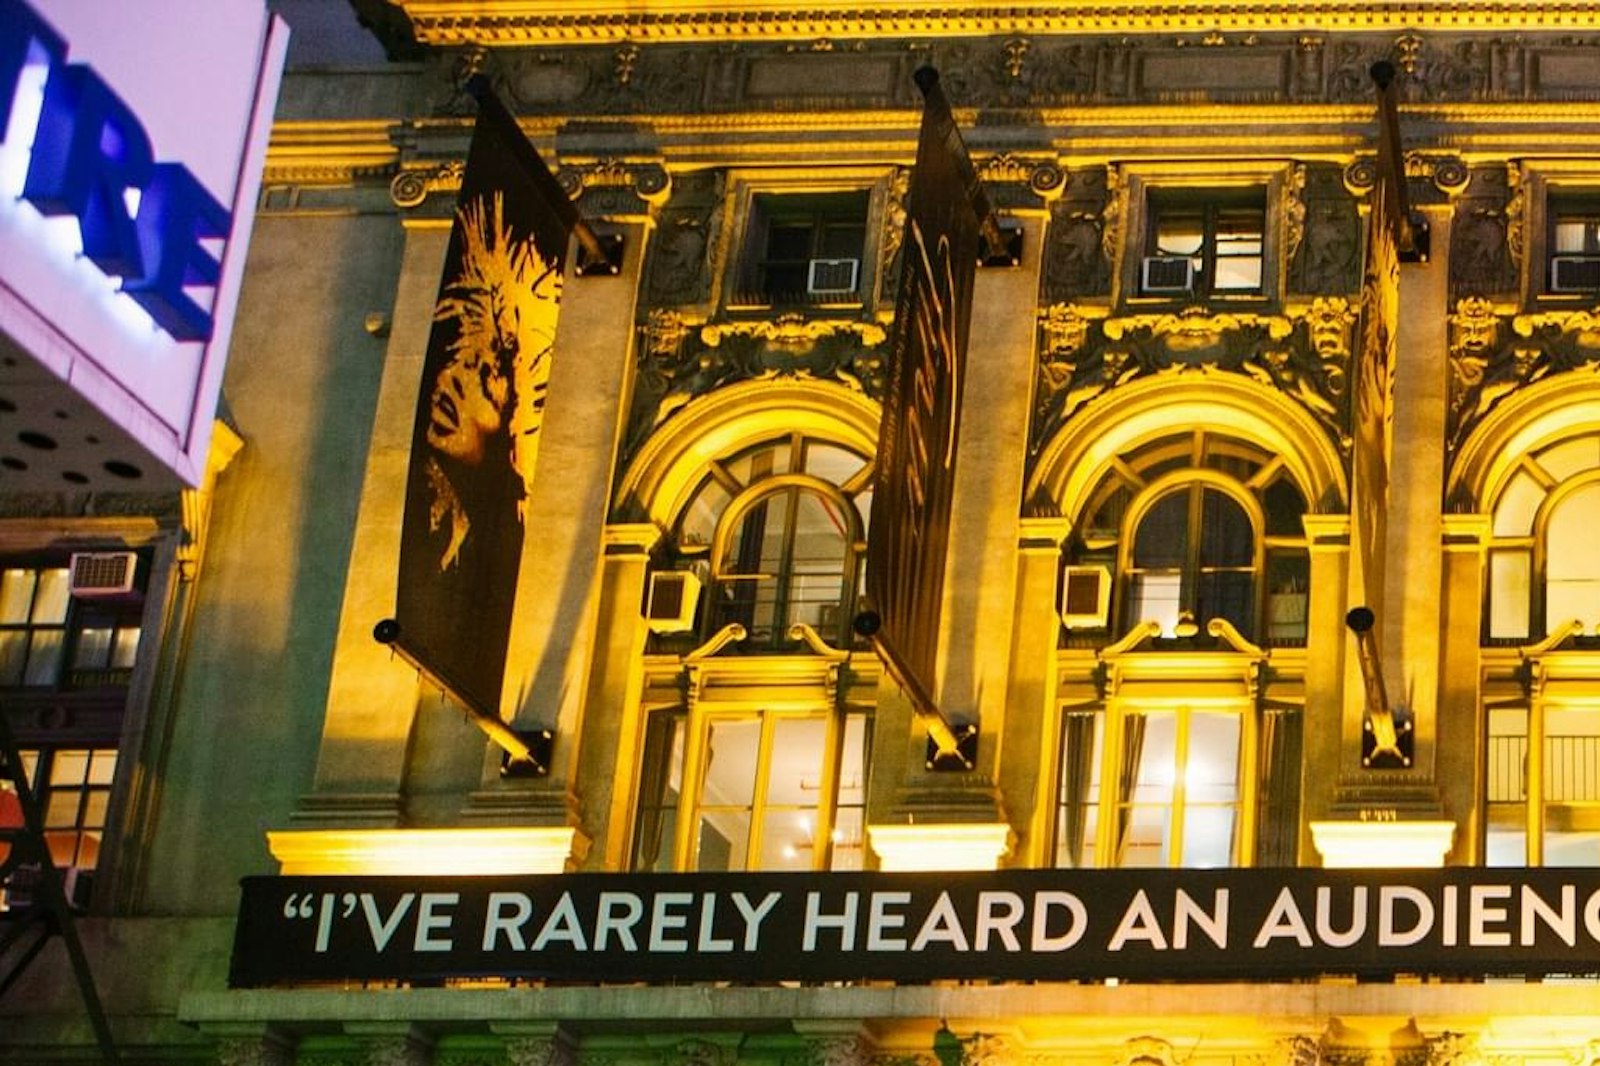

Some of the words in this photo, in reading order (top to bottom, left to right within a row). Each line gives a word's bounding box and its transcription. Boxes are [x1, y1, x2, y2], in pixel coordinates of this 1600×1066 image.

[482, 890, 782, 953] RARELY
[802, 890, 1089, 953] HEARD
[1107, 888, 1229, 951] AN
